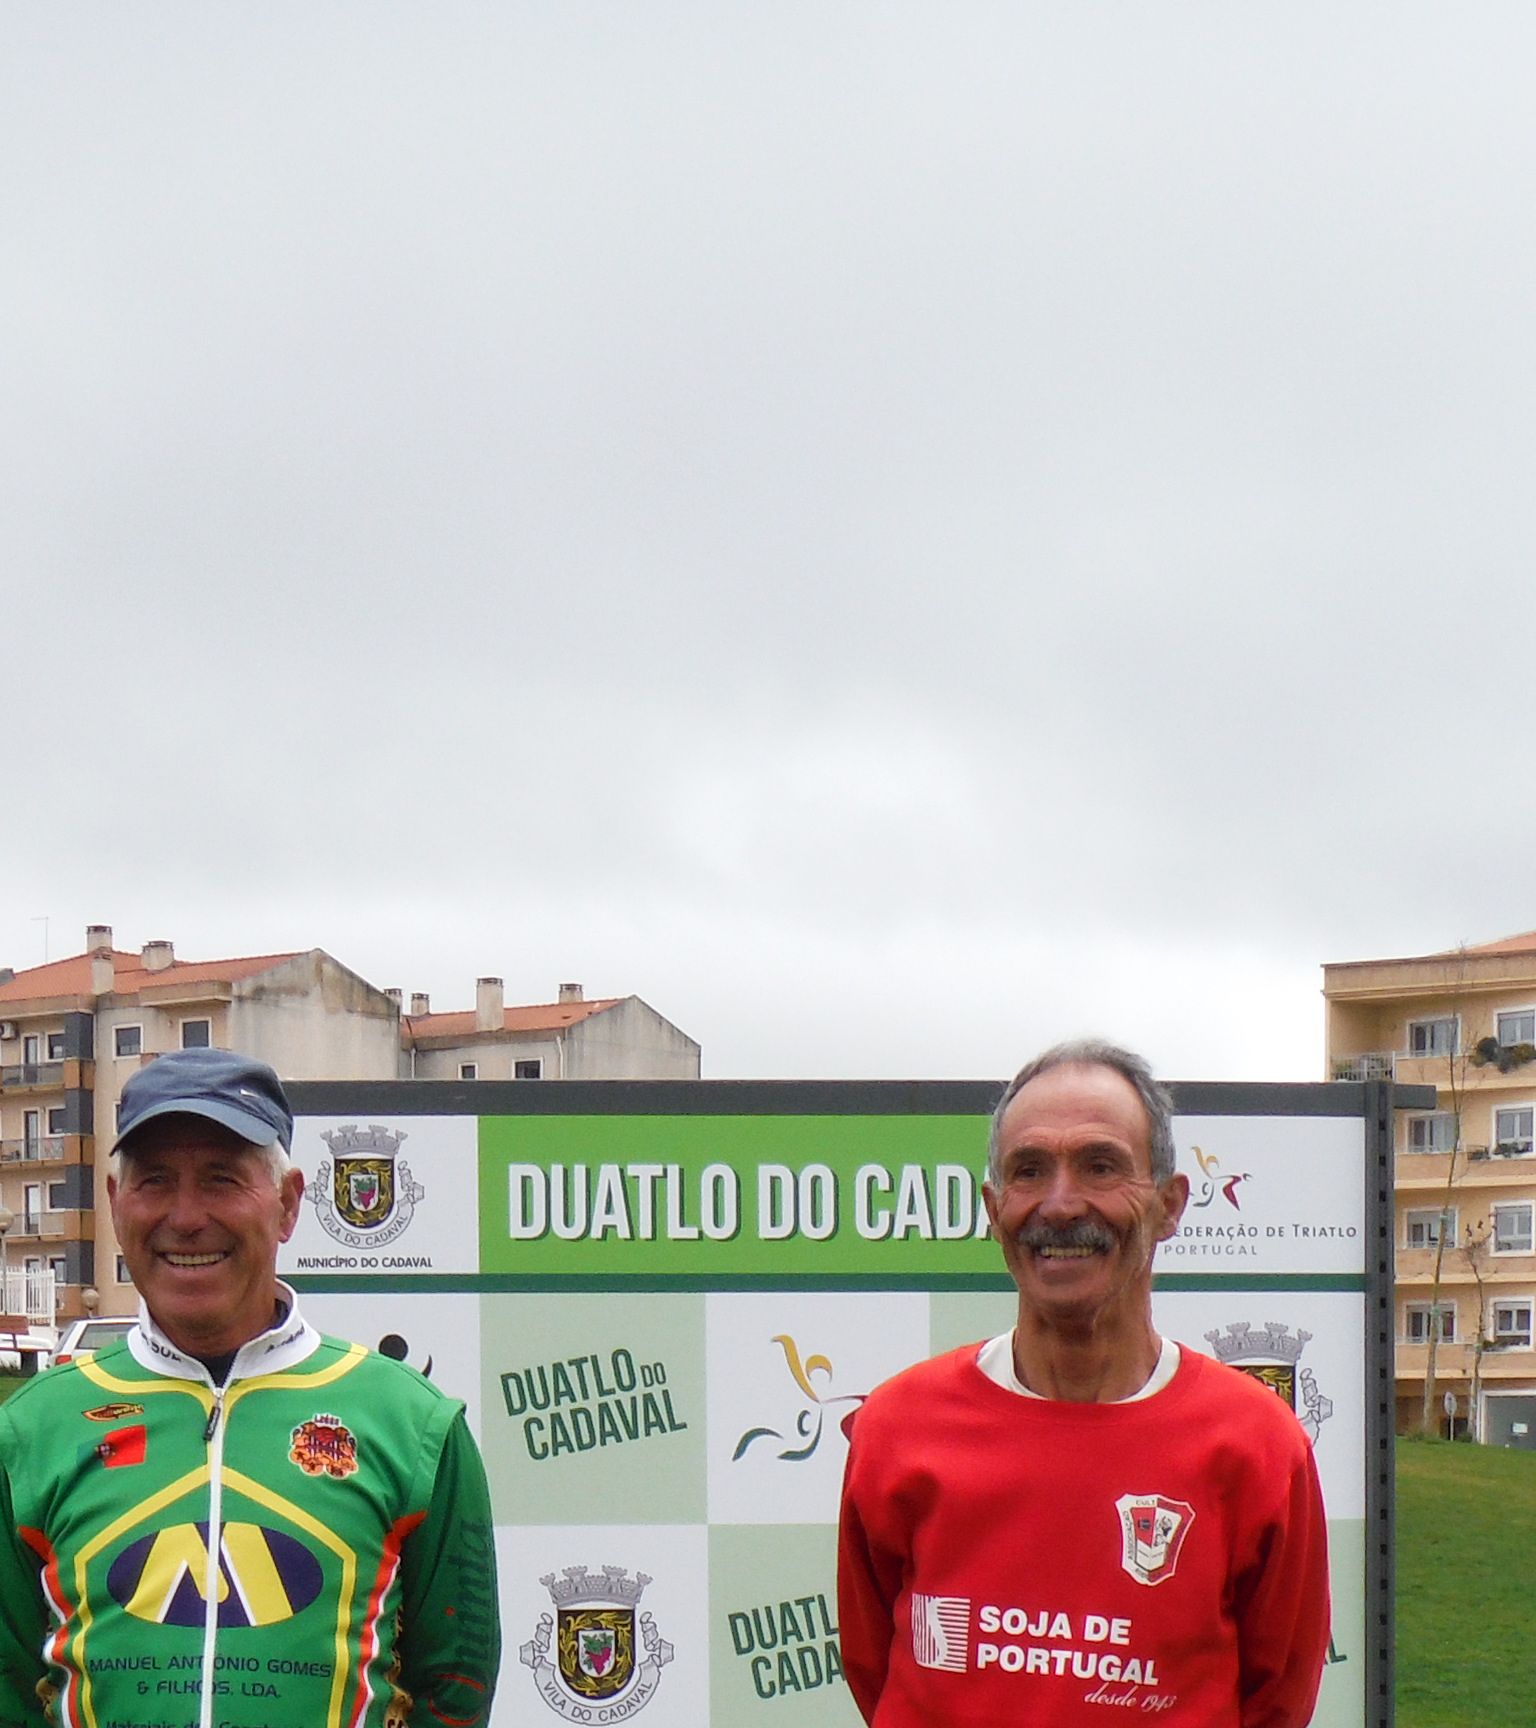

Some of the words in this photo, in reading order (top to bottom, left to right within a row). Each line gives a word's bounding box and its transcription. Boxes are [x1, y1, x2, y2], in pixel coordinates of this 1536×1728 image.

[509, 1163, 739, 1241] DUATLO
[758, 1163, 836, 1241] DO
[855, 1163, 992, 1241] CAD
[323, 1213, 341, 1236] VILA
[344, 1233, 361, 1245] DO
[365, 1214, 408, 1246] CADAVAL
[1165, 1244, 1258, 1256] PORTUGAL
[297, 1254, 358, 1268] MUNICÍPIO
[361, 1256, 379, 1268] DO
[382, 1256, 433, 1268] CADAVAL
[500, 1348, 637, 1416] DUATLO
[640, 1362, 667, 1388] DO
[523, 1389, 688, 1460] CADAVAL
[728, 1594, 841, 1655] DUATL
[979, 1604, 1073, 1640] SOJA
[1083, 1615, 1132, 1645] DE
[89, 1656, 161, 1672] MANUEL
[266, 1659, 332, 1678] GOMES
[751, 1641, 847, 1700] CADA
[976, 1643, 1160, 1686] PORTUGAL
[137, 1680, 149, 1695] &
[543, 1680, 565, 1710] VILA
[571, 1705, 592, 1721] DO
[598, 1680, 653, 1722] CADAVAL
[1084, 1682, 1139, 1709] desde
